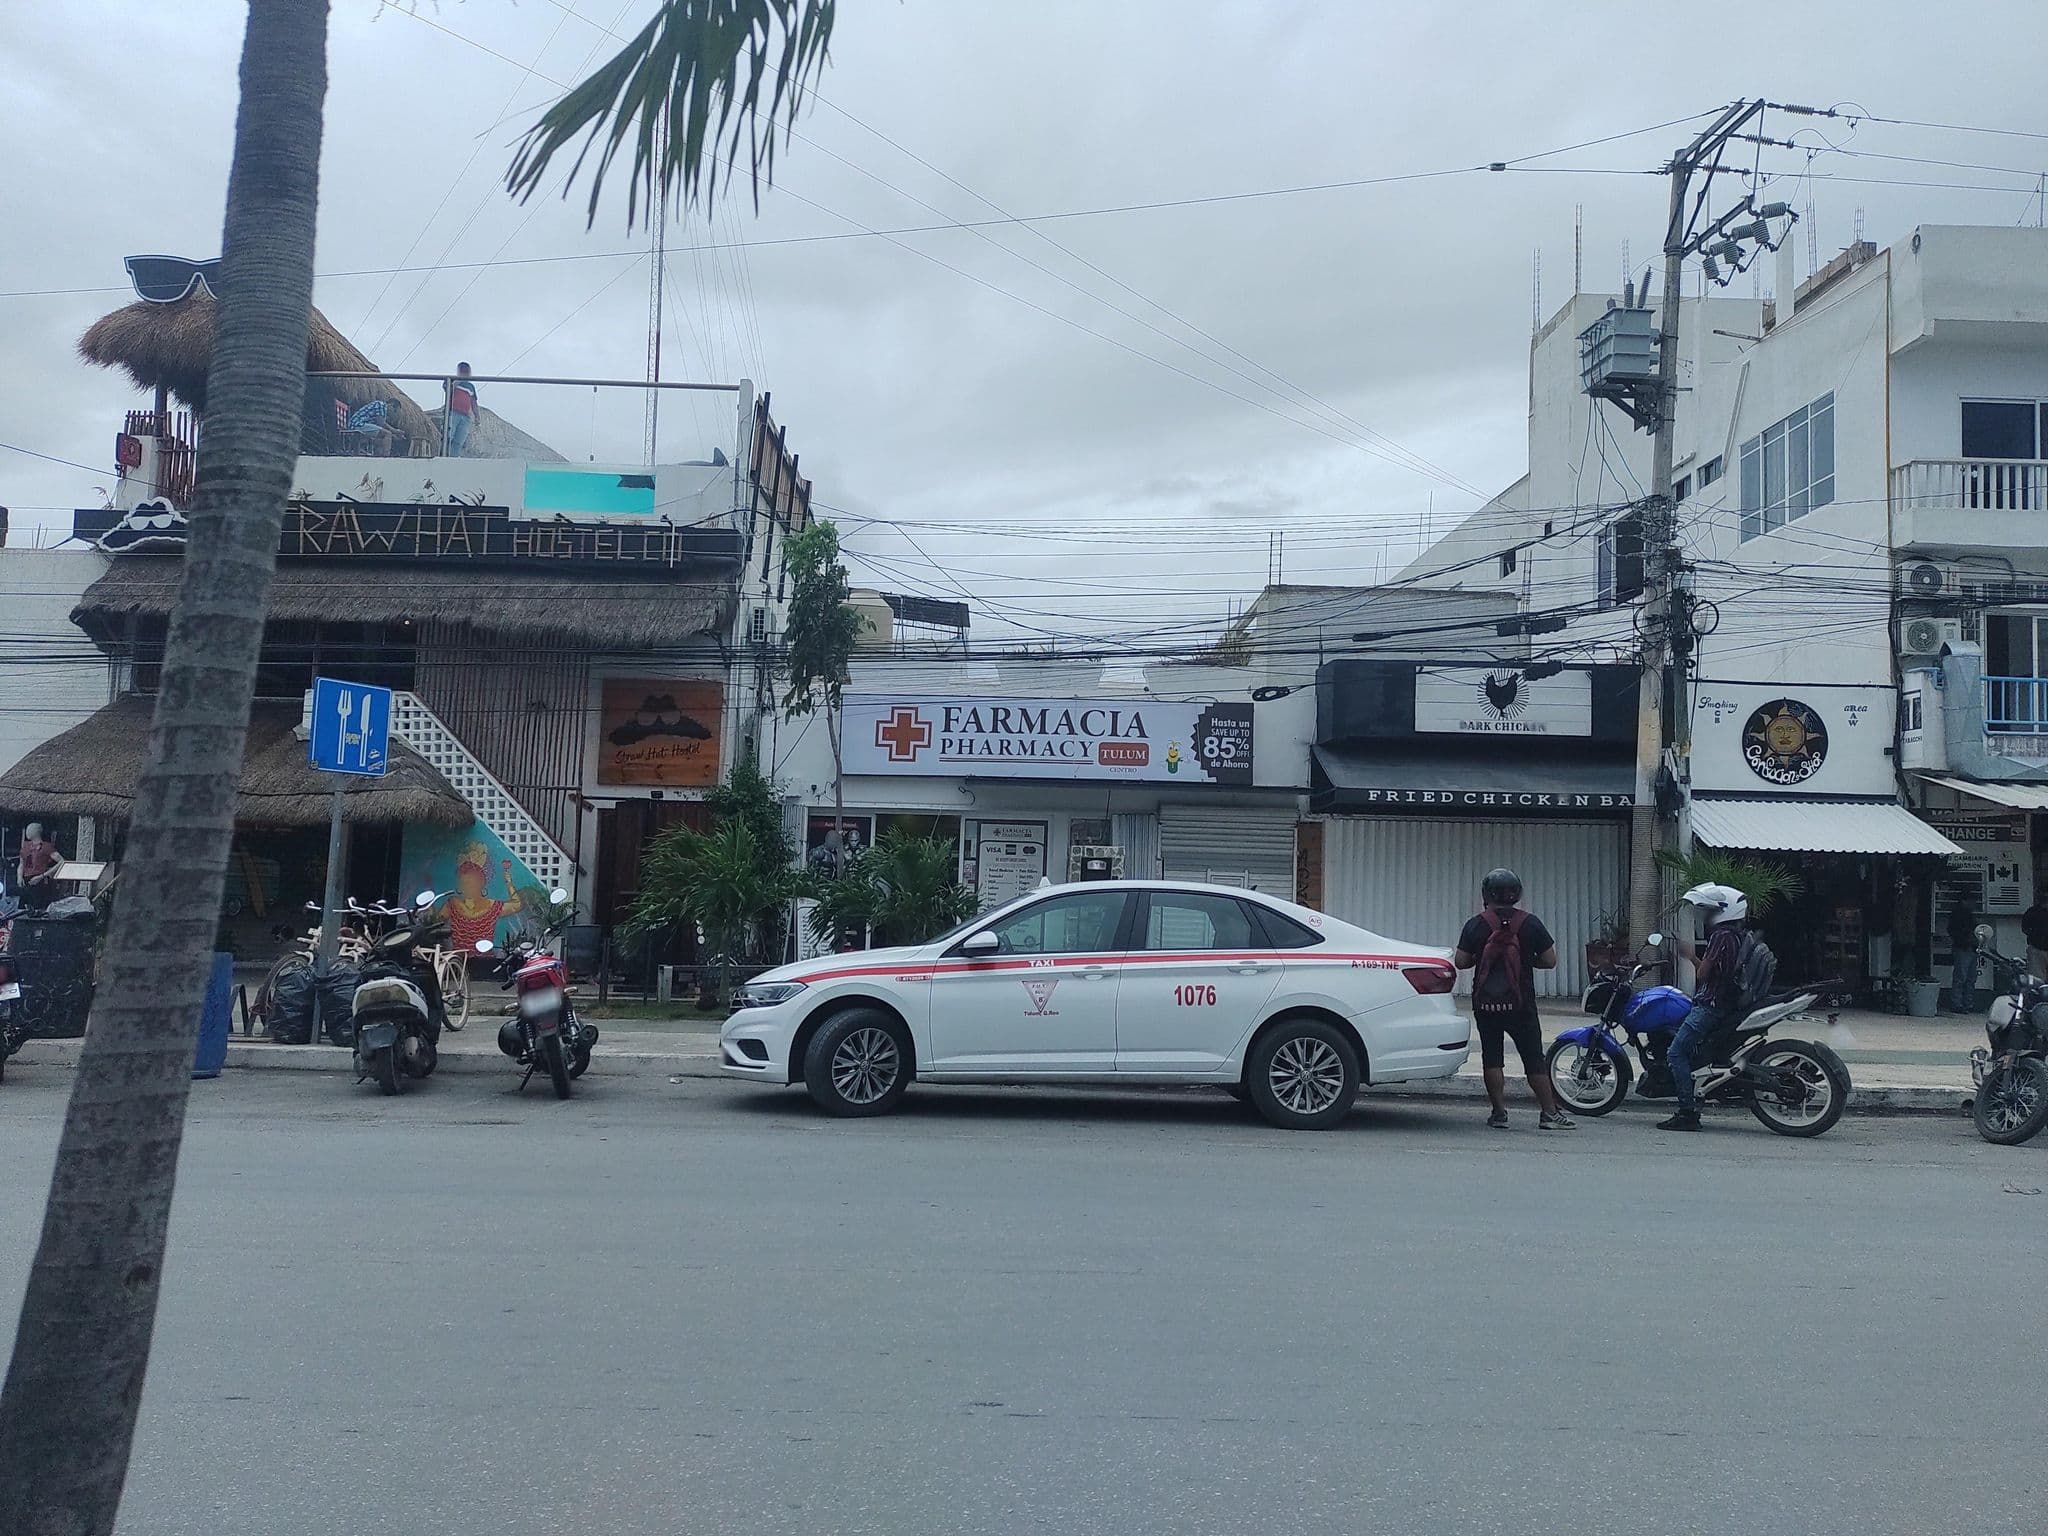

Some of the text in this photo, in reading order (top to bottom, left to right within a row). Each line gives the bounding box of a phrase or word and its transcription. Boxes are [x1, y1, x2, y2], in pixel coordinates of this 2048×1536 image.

[513, 527, 635, 560] HOSTEL
[941, 706, 1150, 739] FARMACIA
[1211, 717, 1250, 728] Hasta un
[1211, 728, 1250, 737] SAVE UP TO
[940, 738, 1093, 758] PHARMACY
[1102, 749, 1147, 760] TULUM
[1203, 736, 1250, 759] 85%
[1210, 759, 1250, 769] de Ahorro
[1368, 790, 1454, 804] FRIED
[1463, 792, 1590, 807] CHICKEN
[1028, 959, 1055, 967] TAXI
[1174, 985, 1216, 1006] 1076
